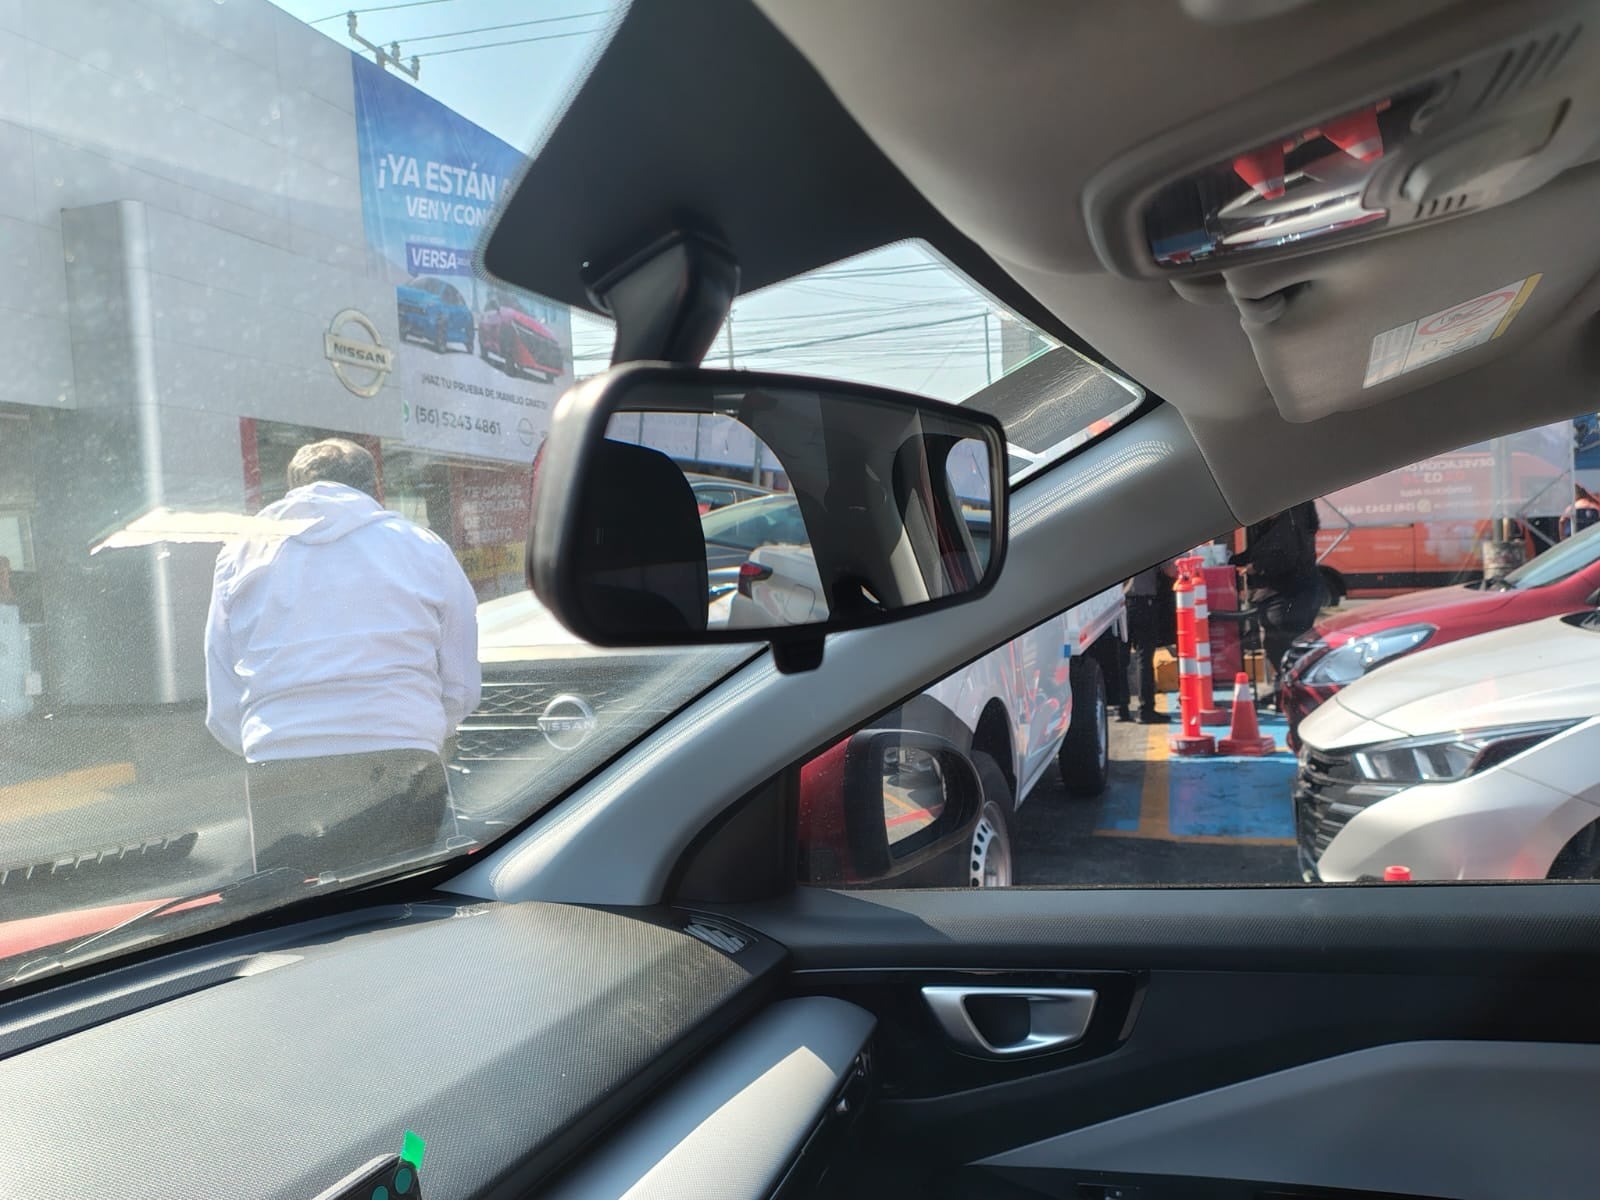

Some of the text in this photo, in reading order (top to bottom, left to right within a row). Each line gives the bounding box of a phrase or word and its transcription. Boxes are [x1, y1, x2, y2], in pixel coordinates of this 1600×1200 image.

[378, 153, 420, 189] ¡YA
[426, 163, 496, 201] ESTÁN
[406, 195, 439, 221] VEN
[439, 202, 451, 222] Y
[411, 247, 457, 270] VERSA
[333, 343, 386, 365] NISSAN
[441, 377, 452, 389] TU
[453, 380, 484, 398] PRUEBA
[484, 387, 495, 400] DE
[415, 404, 502, 436] (56) 5243 4861
[464, 516, 481, 530] DE
